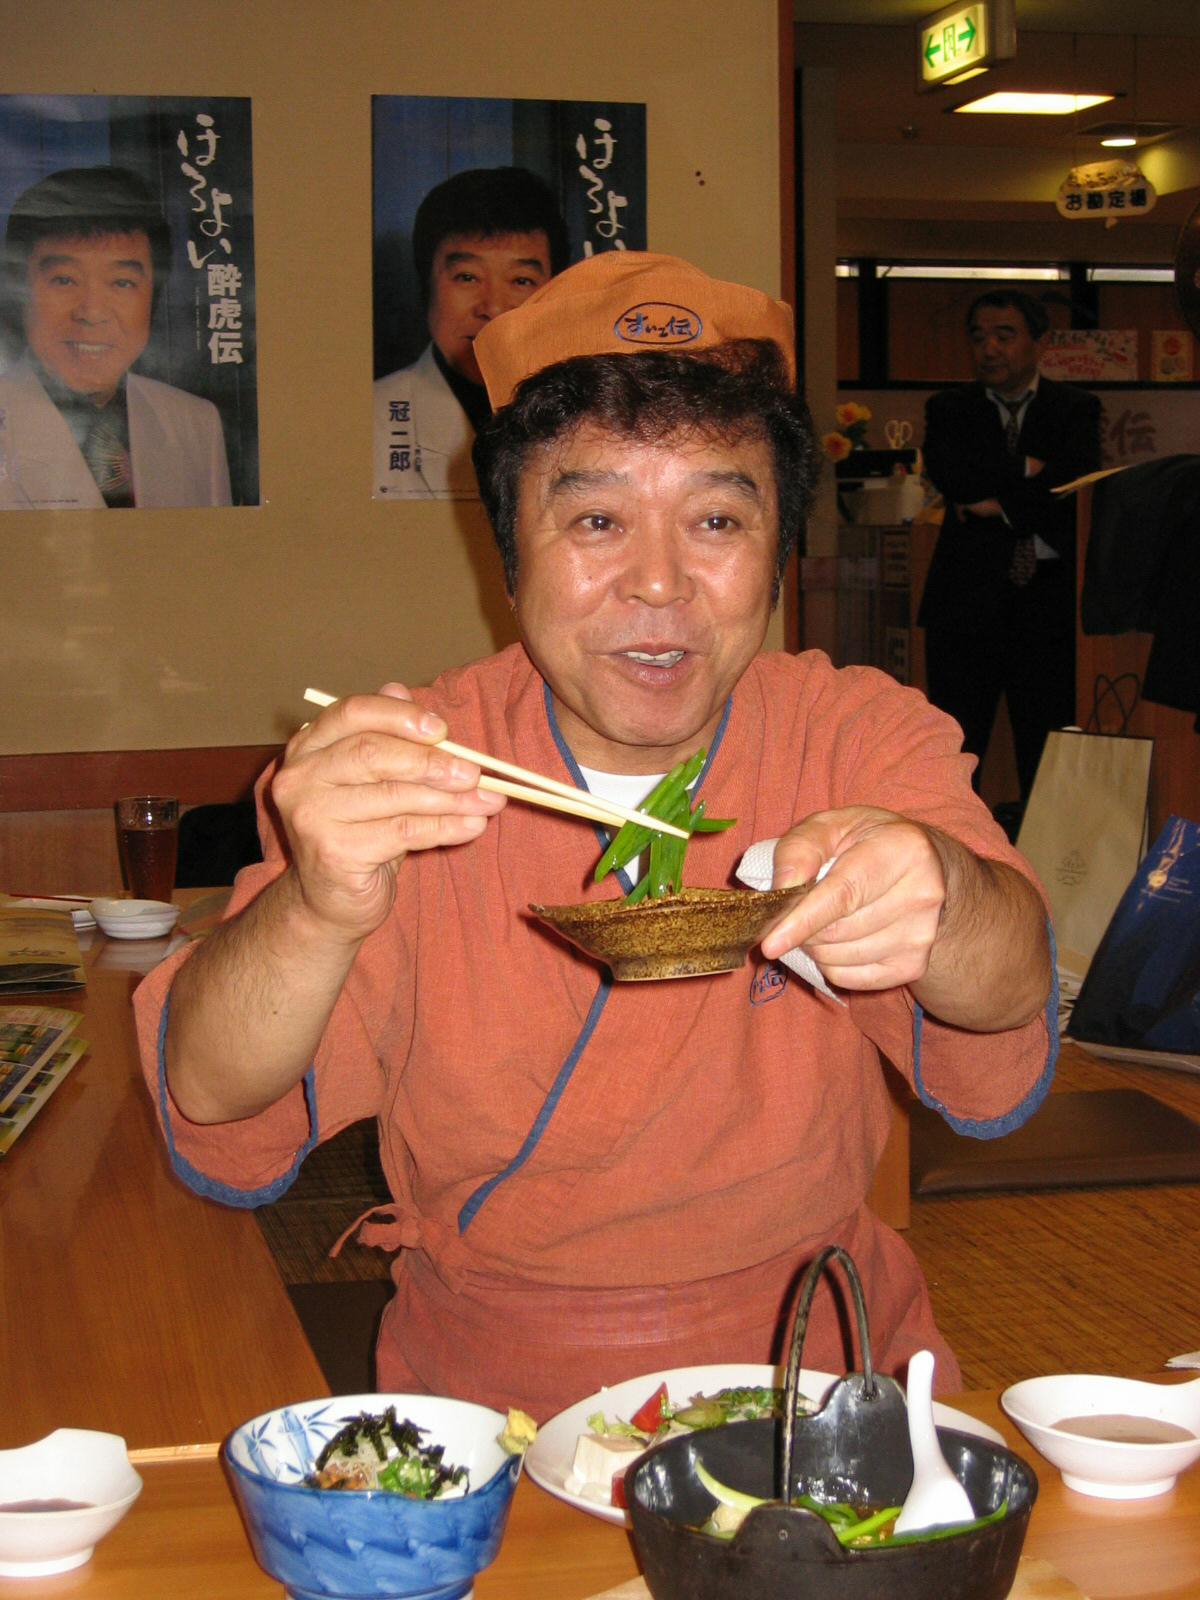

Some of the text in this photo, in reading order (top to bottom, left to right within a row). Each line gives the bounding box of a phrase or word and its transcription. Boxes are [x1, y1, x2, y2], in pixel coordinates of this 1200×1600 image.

[207, 263, 244, 364] 酔虎伝
[389, 400, 411, 472] 冠二郎
